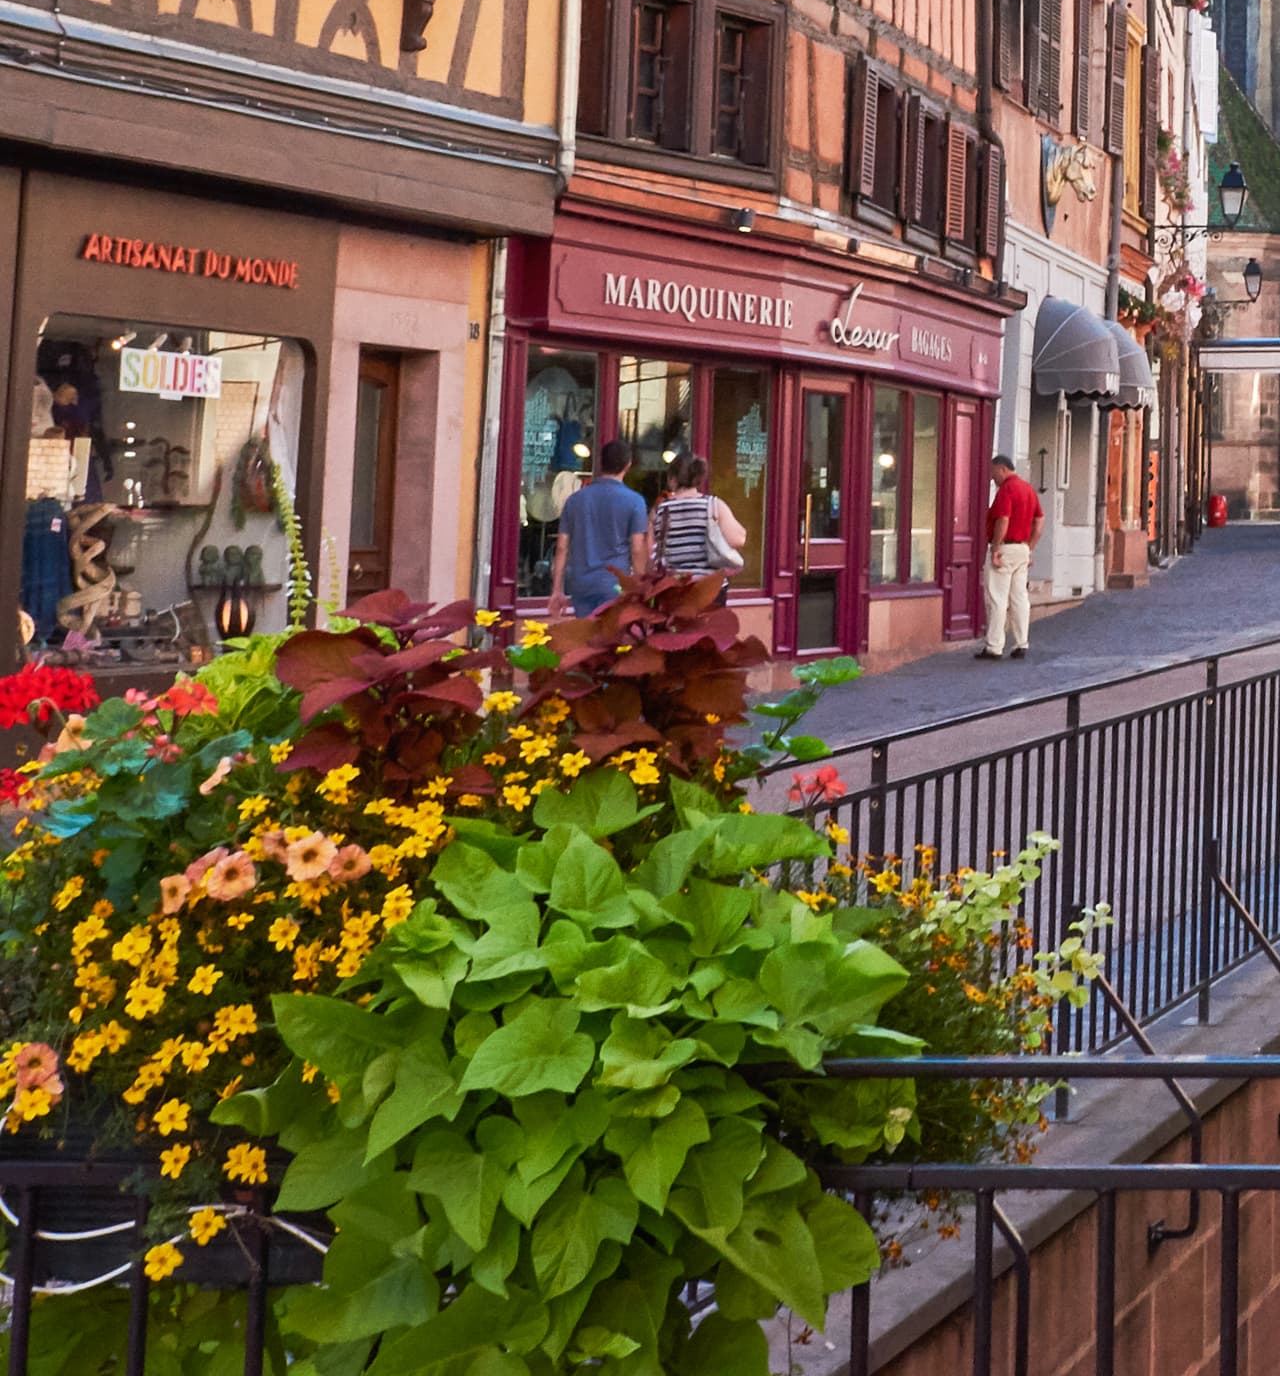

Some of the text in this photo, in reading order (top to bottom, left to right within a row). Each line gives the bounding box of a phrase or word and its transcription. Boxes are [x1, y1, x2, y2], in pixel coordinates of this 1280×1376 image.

[84, 233, 299, 289] ARTISANAT DU MONDE
[604, 272, 794, 330] MAROQUINERIE
[830, 281, 900, 351] Lesur
[469, 322, 480, 340] 18
[911, 326, 952, 362] BAGAGES
[124, 351, 219, 393] SOLDES
